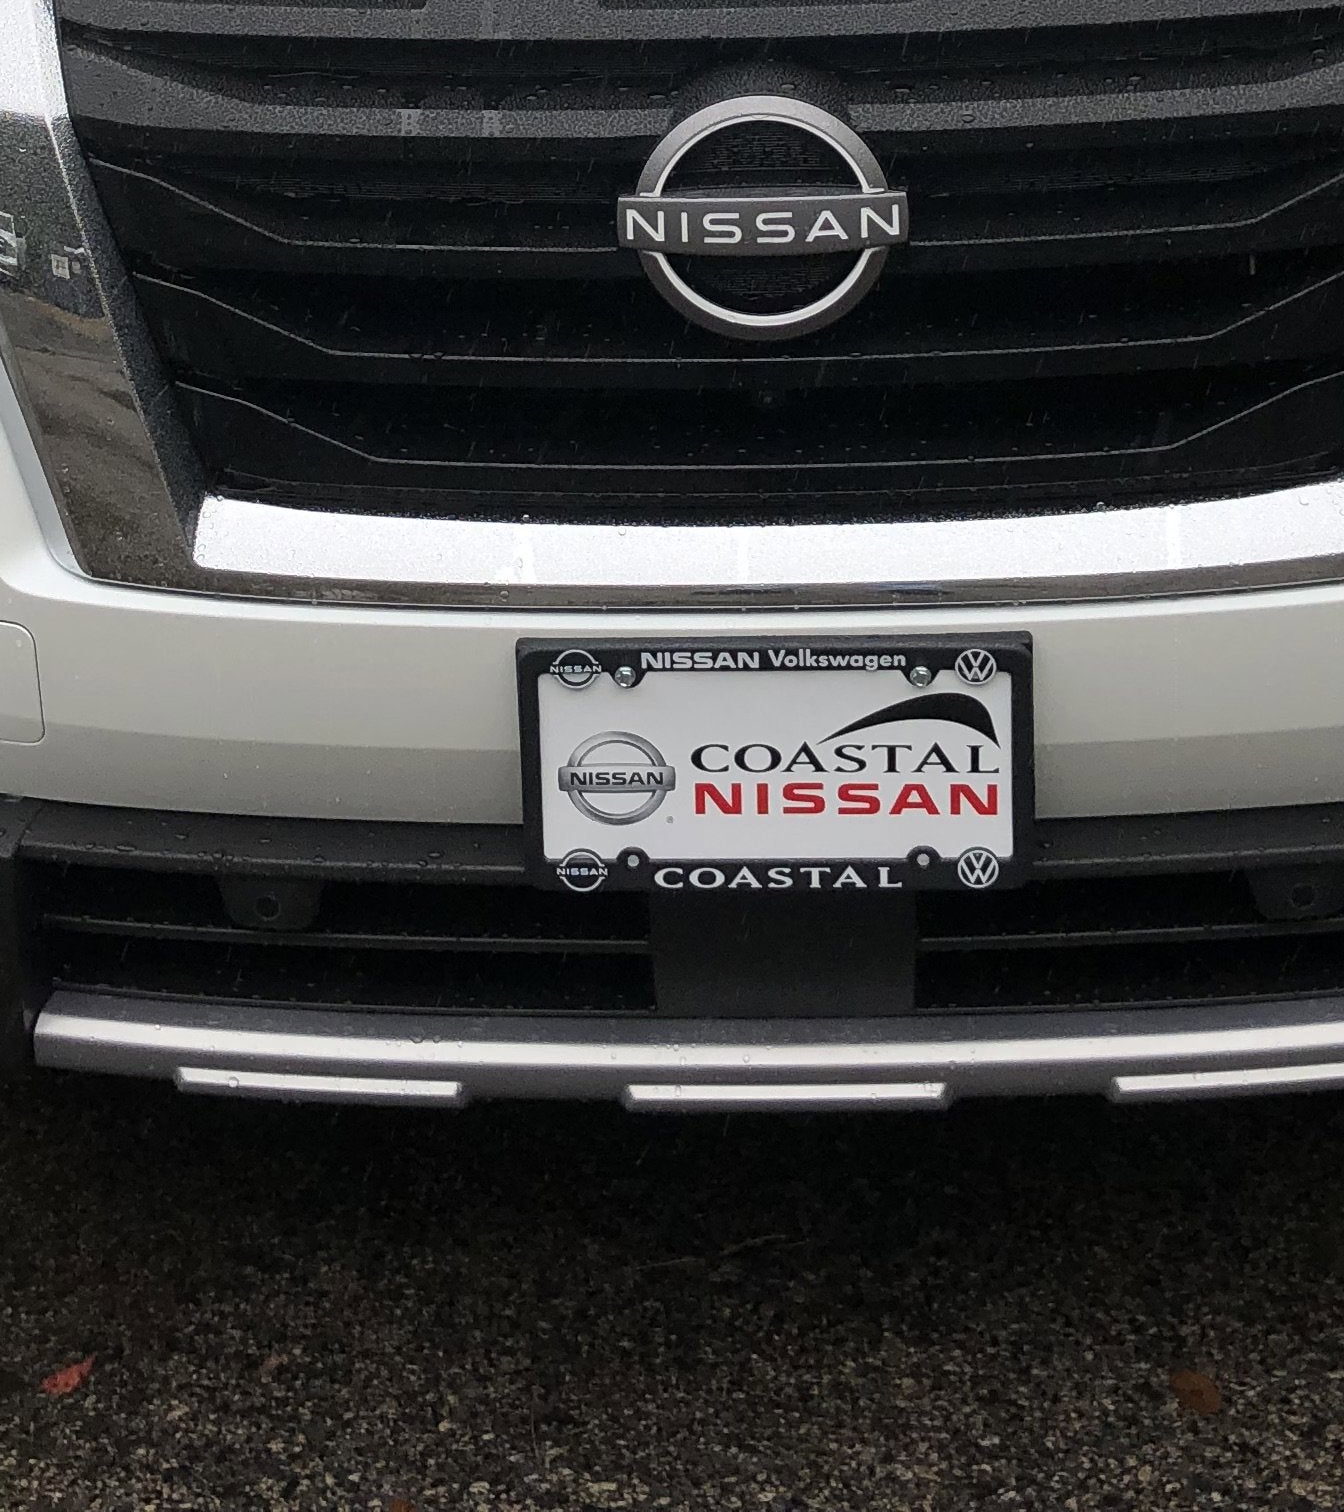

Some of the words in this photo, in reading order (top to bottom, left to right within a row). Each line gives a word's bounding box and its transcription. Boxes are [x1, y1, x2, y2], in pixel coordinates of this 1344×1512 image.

[625, 204, 900, 244] NISSAN
[549, 665, 602, 674] NISSAN
[640, 651, 760, 670] NISSAN
[767, 648, 907, 670] Volkswagen
[690, 740, 1000, 774] COASTAL
[570, 771, 664, 786] NISSAN
[693, 782, 999, 816] NISSAN
[556, 867, 608, 876] NISSAN
[654, 865, 903, 888] COASTAL
